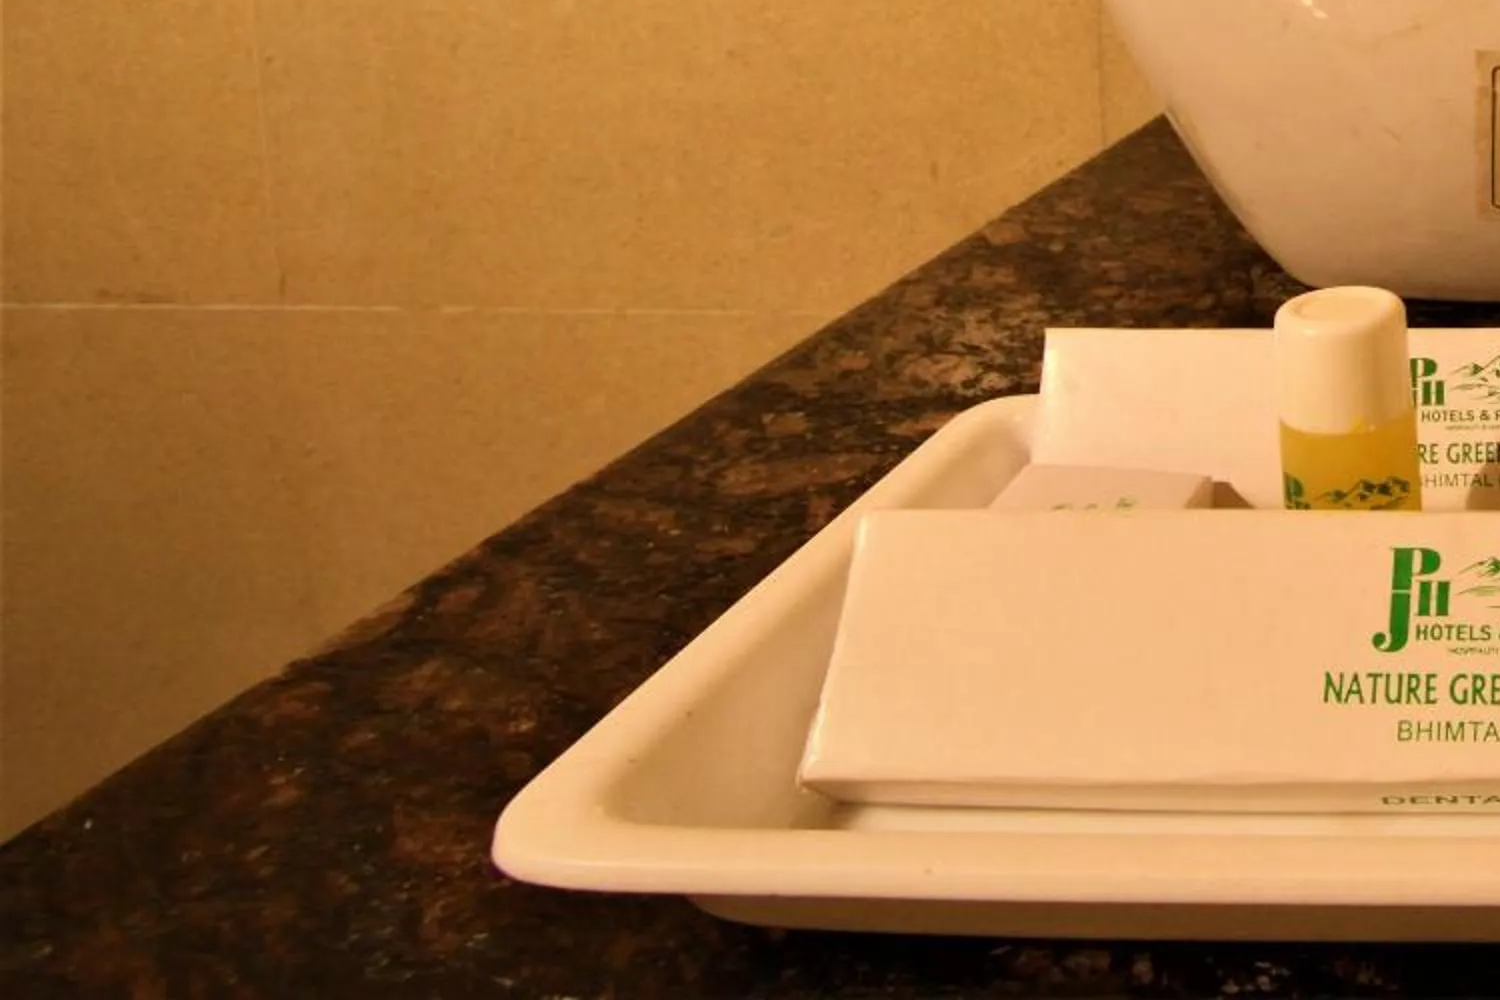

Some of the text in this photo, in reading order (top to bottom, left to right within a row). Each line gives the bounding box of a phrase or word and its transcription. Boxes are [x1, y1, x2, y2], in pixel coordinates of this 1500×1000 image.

[1420, 409, 1475, 422] HOTELS
[1419, 472, 1495, 489] HIMTAL
[1415, 623, 1492, 643] HOTELS
[1322, 671, 1439, 705] NATURE
